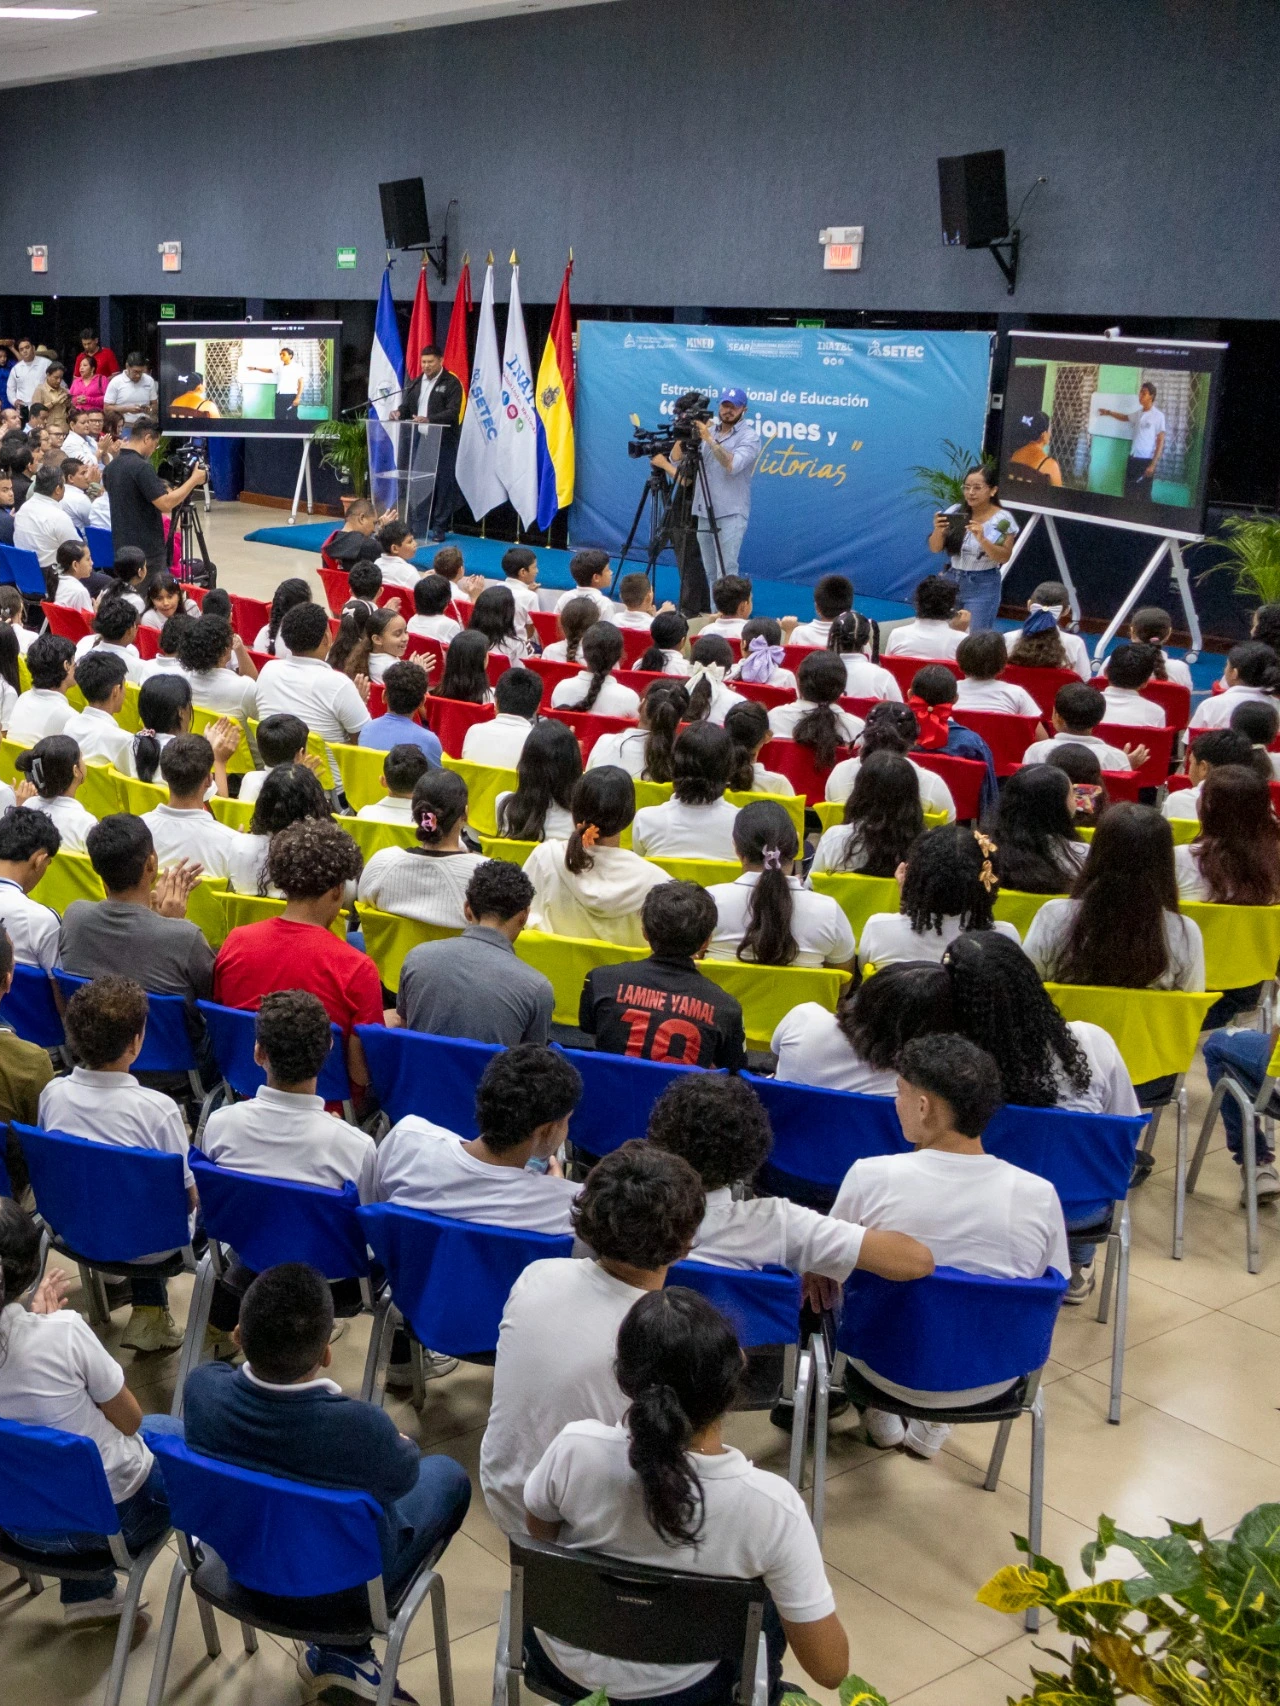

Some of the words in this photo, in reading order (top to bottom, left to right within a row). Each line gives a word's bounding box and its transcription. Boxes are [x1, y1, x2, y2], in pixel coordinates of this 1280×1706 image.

[816, 341, 854, 352] INATEC
[882, 345, 925, 358] SETEC
[505, 353, 536, 412] INAT
[471, 386, 498, 441] SETEC
[780, 390, 796, 403] de
[800, 391, 869, 408] Educación
[827, 430, 838, 446] y
[616, 983, 669, 1012] LAMINE
[671, 993, 716, 1026] YAMAL
[621, 1008, 702, 1066] 10
